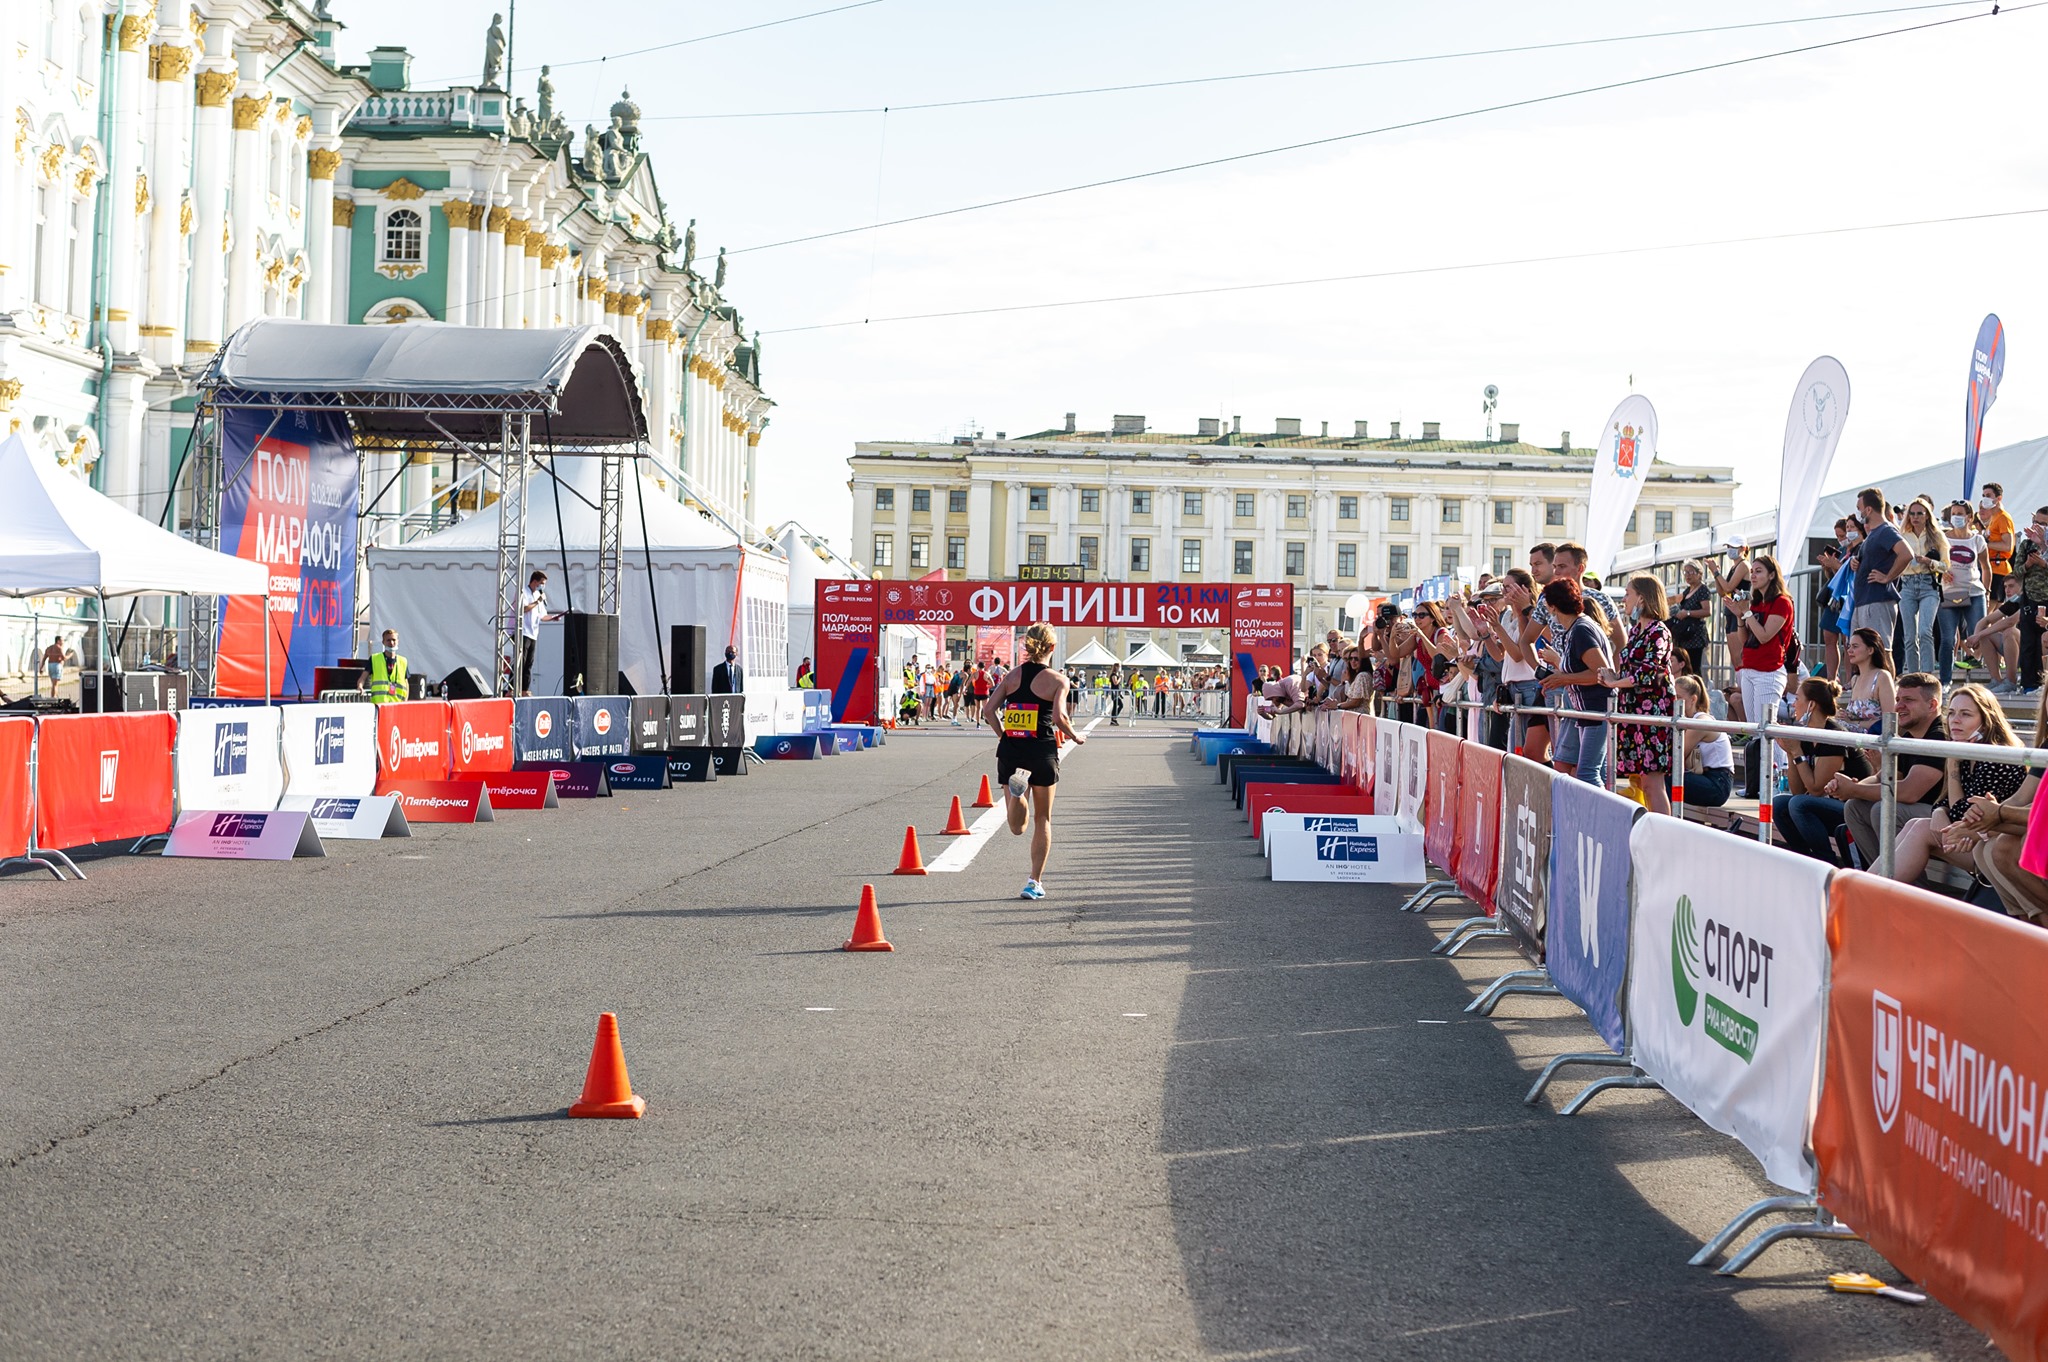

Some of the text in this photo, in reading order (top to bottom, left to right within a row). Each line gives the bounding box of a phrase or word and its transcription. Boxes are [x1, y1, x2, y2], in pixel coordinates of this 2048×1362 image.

[257, 450, 306, 506] ПОЛУ
[256, 512, 341, 571] МАРАФОН
[969, 586, 1145, 622] ФИНИШ
[1157, 585, 1229, 605] 21,1 КМ
[822, 614, 850, 623] ПОЛУ
[884, 609, 954, 621] 9.08.2020
[1157, 605, 1219, 624] 10 КМ
[1235, 619, 1261, 628] ПОЛУ
[822, 624, 872, 633] МАРАФОН
[1234, 629, 1283, 638] МАРАФОН
[1007, 712, 1032, 724] 6011
[402, 738, 439, 762] Пятёрочка
[474, 733, 504, 755] Пятёрочка
[609, 744, 622, 754] PASTA
[405, 796, 469, 808] Пятёрочка
[1704, 918, 1773, 1008] СПОРТ
[1706, 1004, 1756, 1054] РИА НОВОСТИ
